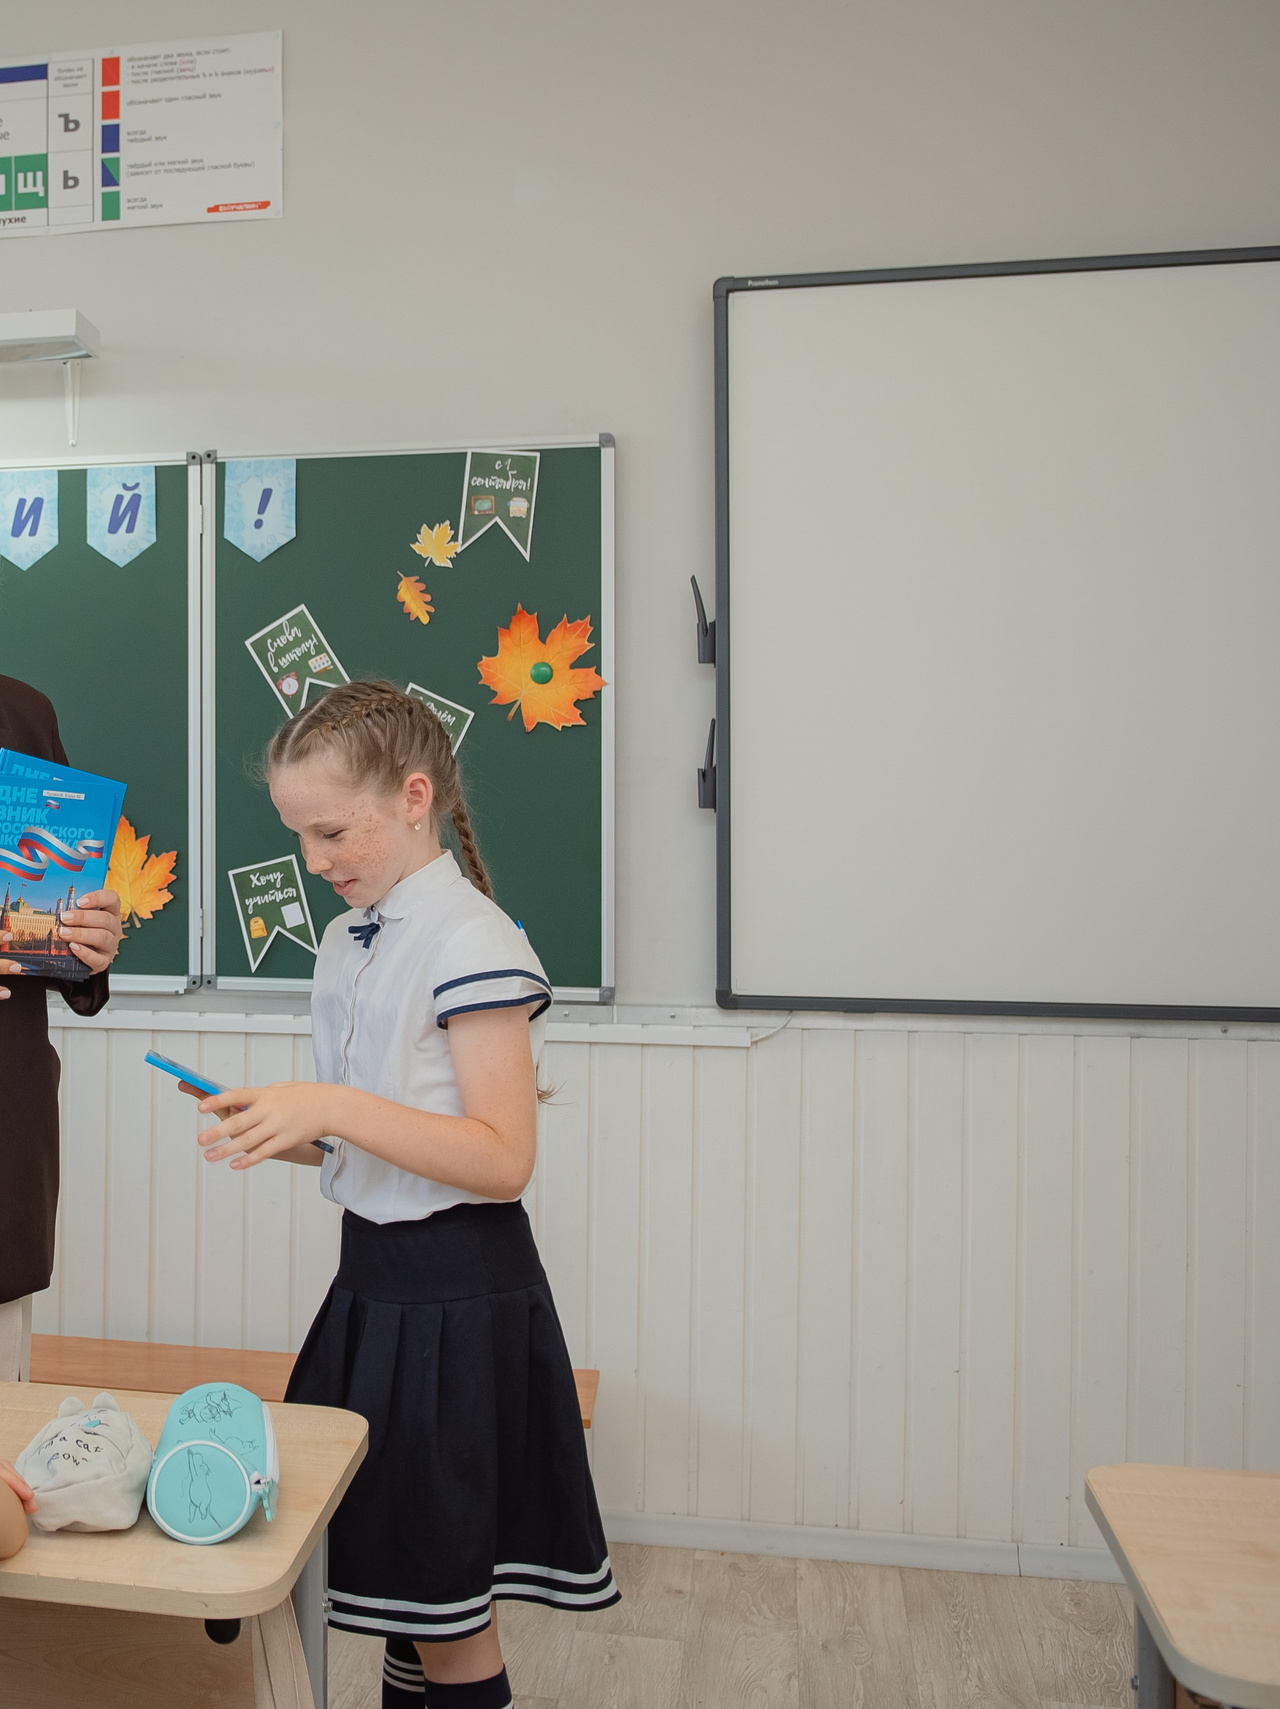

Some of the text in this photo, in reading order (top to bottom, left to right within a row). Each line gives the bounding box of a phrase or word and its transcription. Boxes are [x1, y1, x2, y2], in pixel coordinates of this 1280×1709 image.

[471, 470, 531, 492] сентября!
[267, 620, 302, 653] Снова
[249, 871, 284, 888] Хочу
[245, 887, 297, 915] учиться
